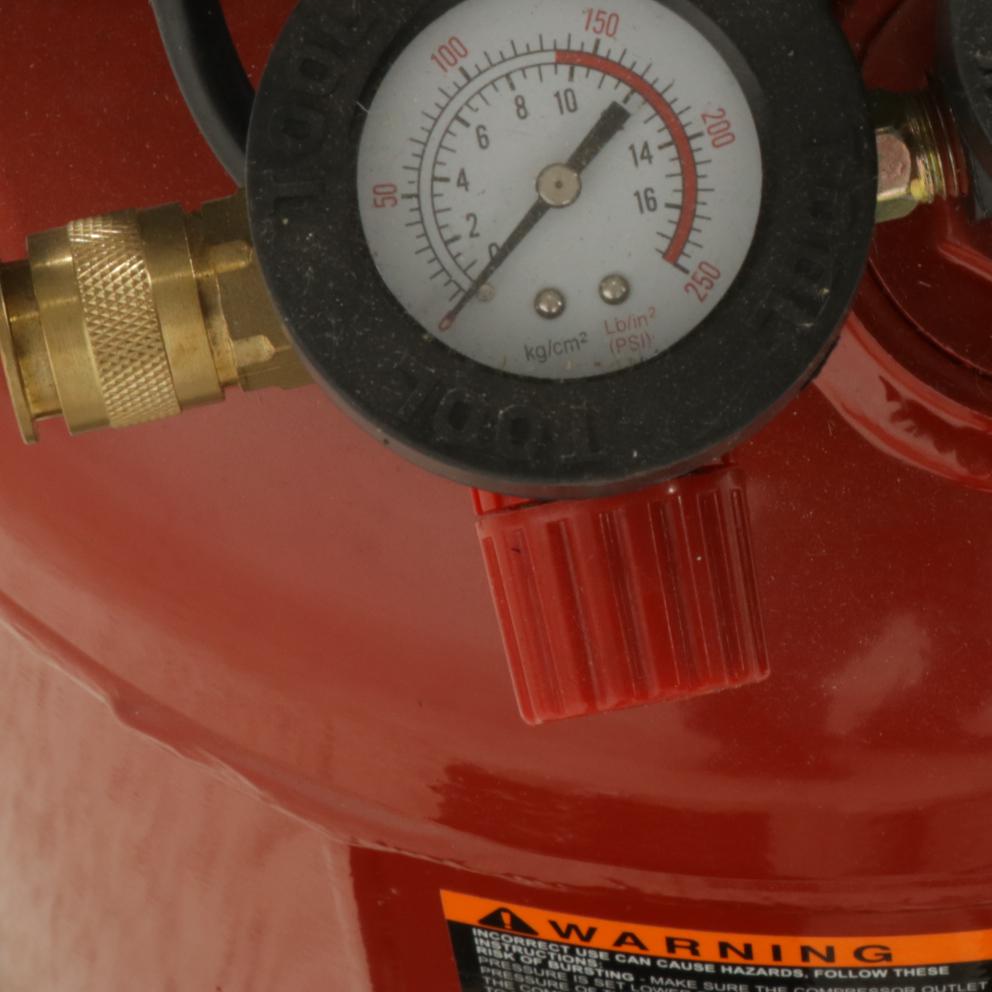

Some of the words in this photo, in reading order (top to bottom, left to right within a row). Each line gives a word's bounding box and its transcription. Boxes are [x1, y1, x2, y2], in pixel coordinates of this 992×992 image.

[582, 7, 619, 39] 150
[430, 35, 470, 73] 100
[515, 95, 529, 121] 8
[555, 88, 579, 114] 10
[475, 125, 491, 150] 6
[700, 106, 736, 150] 200
[628, 140, 655, 167] 14
[455, 167, 471, 192] 4
[372, 182, 399, 209] 50
[634, 187, 658, 215] 16
[466, 213, 480, 238] 2
[684, 260, 723, 303] 250
[609, 332, 654, 357] (PSI)
[472, 927, 570, 955] INCORRECT
[575, 947, 609, 962] USE
[615, 953, 652, 967] CAN
[656, 958, 716, 974] CAUSE
[814, 968, 888, 980] FOLLOW
[893, 965, 950, 978] THESE
[548, 919, 893, 964] WARNING
[477, 946, 516, 962] RISK
[520, 955, 543, 966] OF
[548, 959, 636, 982] BURSTING
[650, 975, 698, 989] MAKE
[703, 980, 749, 992] SURE
[921, 980, 989, 992] OUTLET
[479, 956, 569, 982] PRESSURE
[573, 974, 591, 986] IS
[594, 978, 626, 990] SET
[481, 965, 569, 991] PRESSURE
